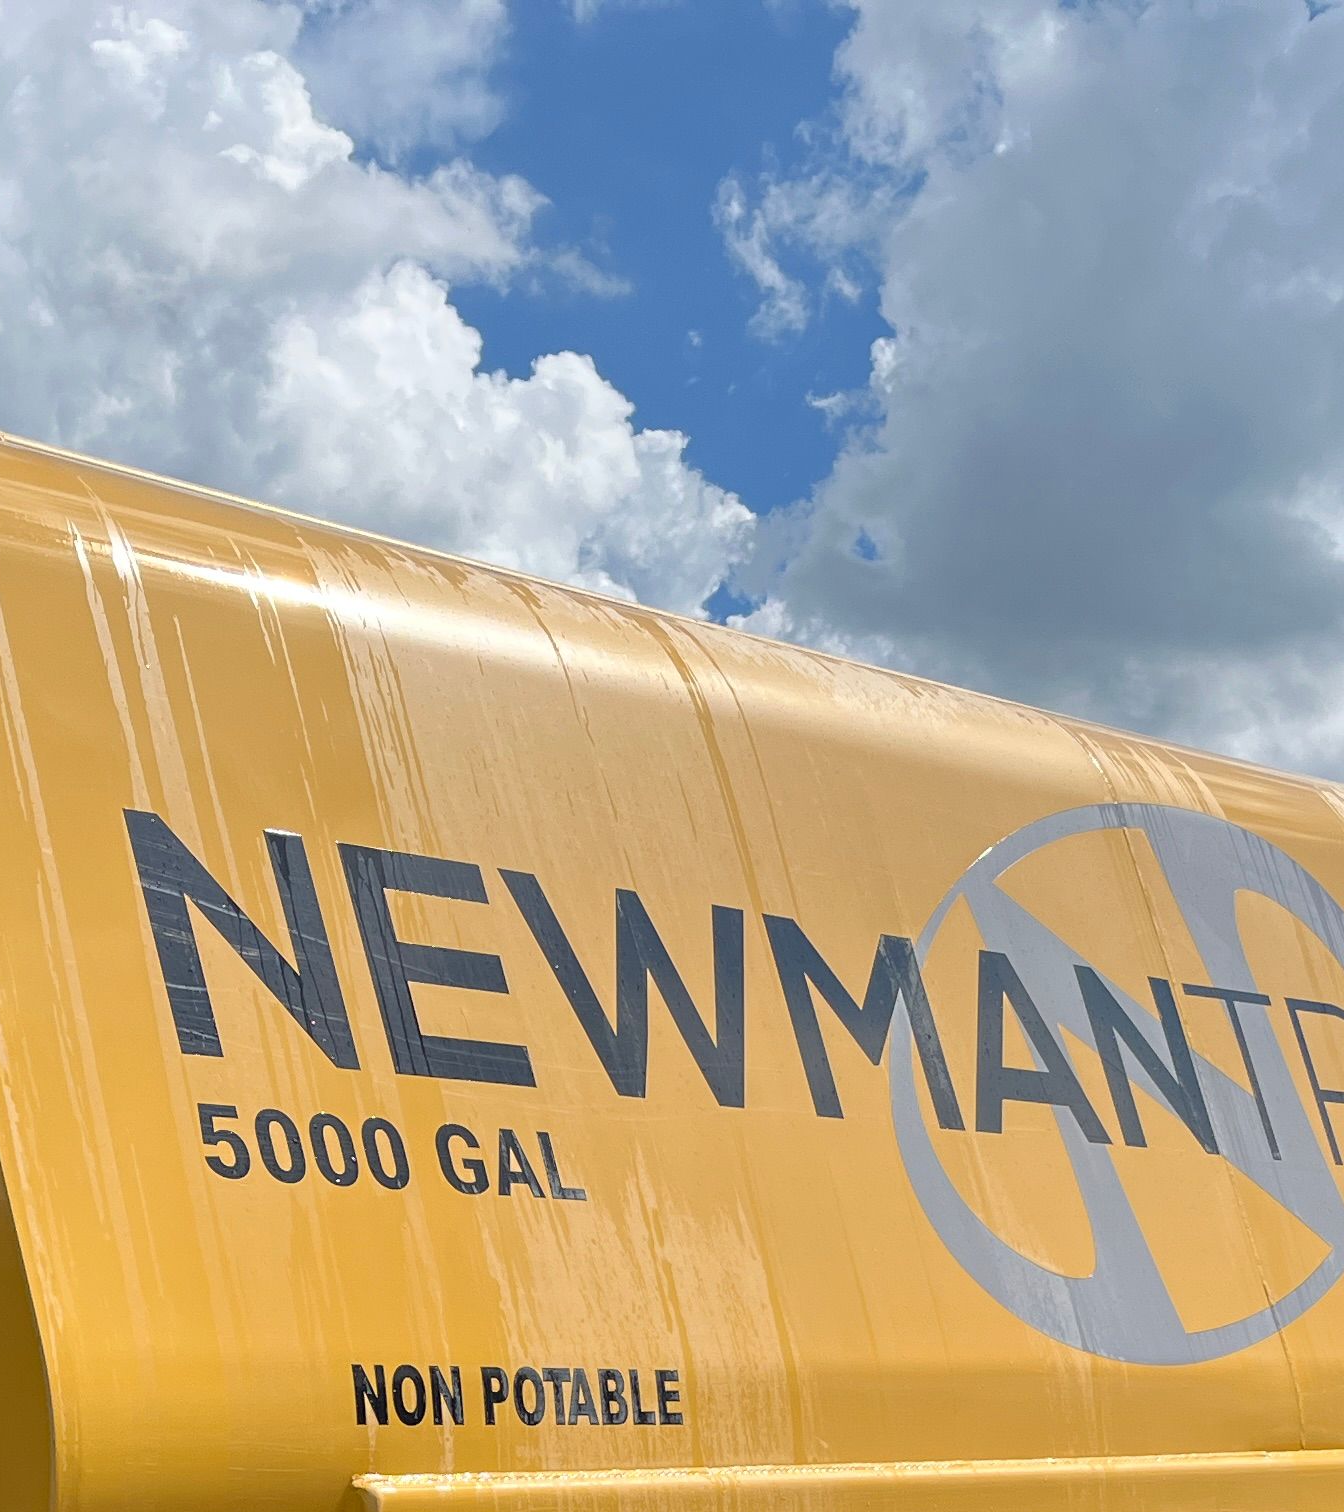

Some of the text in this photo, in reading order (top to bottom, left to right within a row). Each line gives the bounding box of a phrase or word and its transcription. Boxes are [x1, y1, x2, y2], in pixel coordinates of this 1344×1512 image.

[197, 1101, 587, 1201] 5000 GAL
[351, 1364, 684, 1427] NON POTABLE
